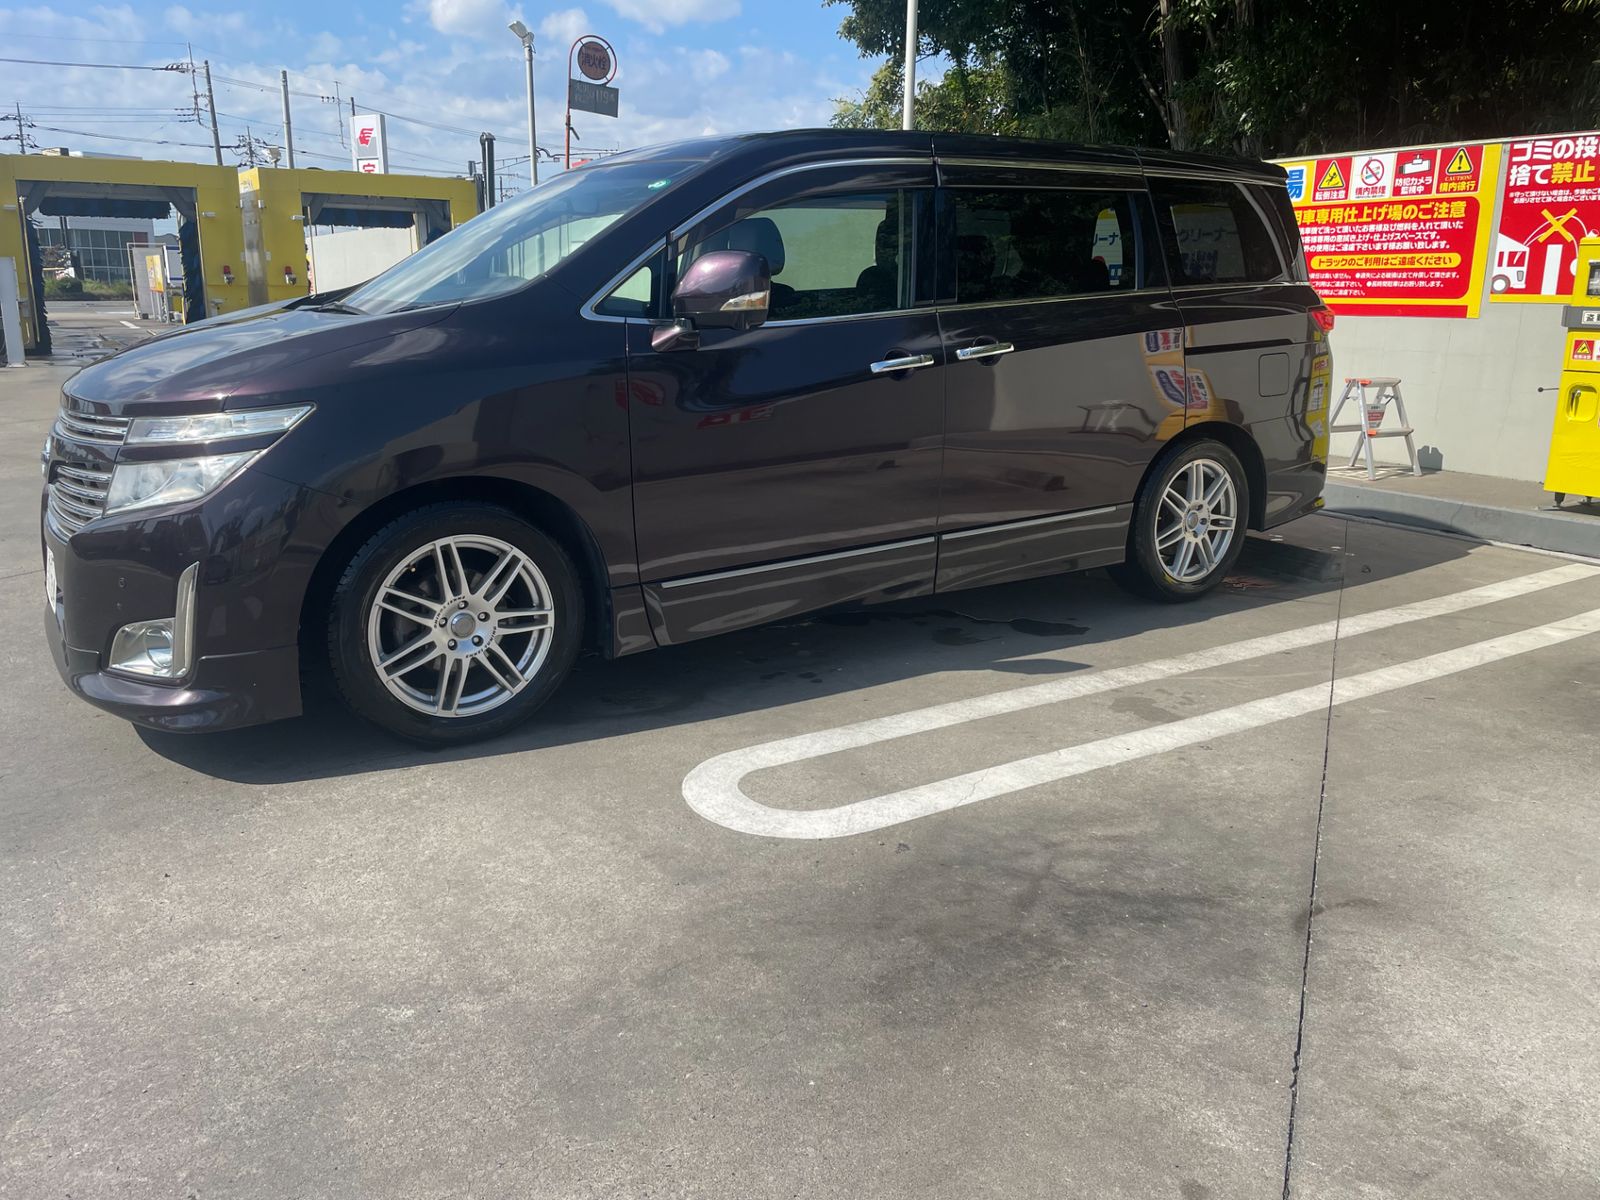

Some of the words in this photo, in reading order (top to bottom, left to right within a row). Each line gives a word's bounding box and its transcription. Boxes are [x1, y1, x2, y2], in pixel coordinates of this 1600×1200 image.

[1512, 136, 1600, 162] ゴミの投
[1509, 160, 1596, 187] 捨て禁止
[1395, 176, 1433, 188] 防犯カメラ
[1439, 180, 1477, 193] 構内徐行
[1315, 189, 1346, 200] 転倒注意
[1355, 185, 1387, 196] 構内禁煙
[1400, 184, 1425, 195] 監視中
[1318, 255, 1453, 267] トラックのご利用はご遠慮ください
